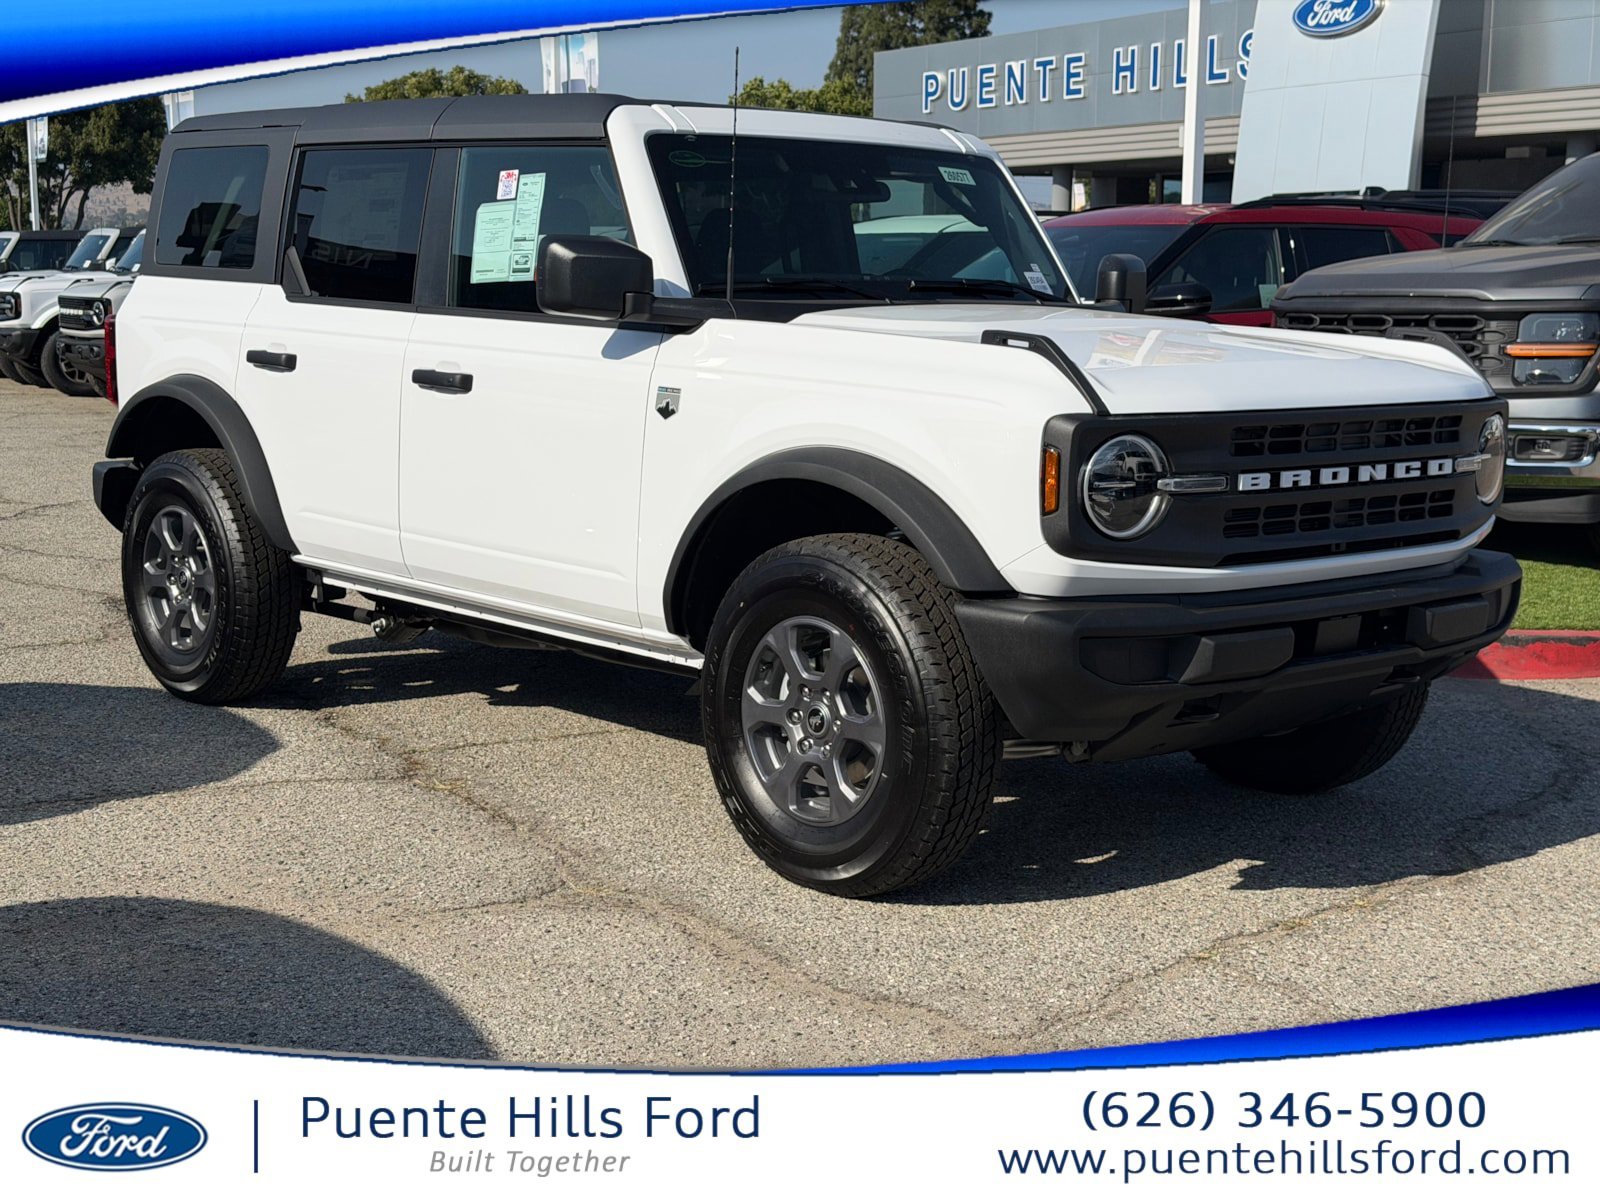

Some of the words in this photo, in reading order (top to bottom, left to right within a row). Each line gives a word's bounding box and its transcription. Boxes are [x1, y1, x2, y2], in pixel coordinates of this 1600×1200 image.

[1307, 0, 1358, 27] Ford
[922, 53, 1086, 114] PUENTE
[1238, 457, 1454, 491] BRONCO
